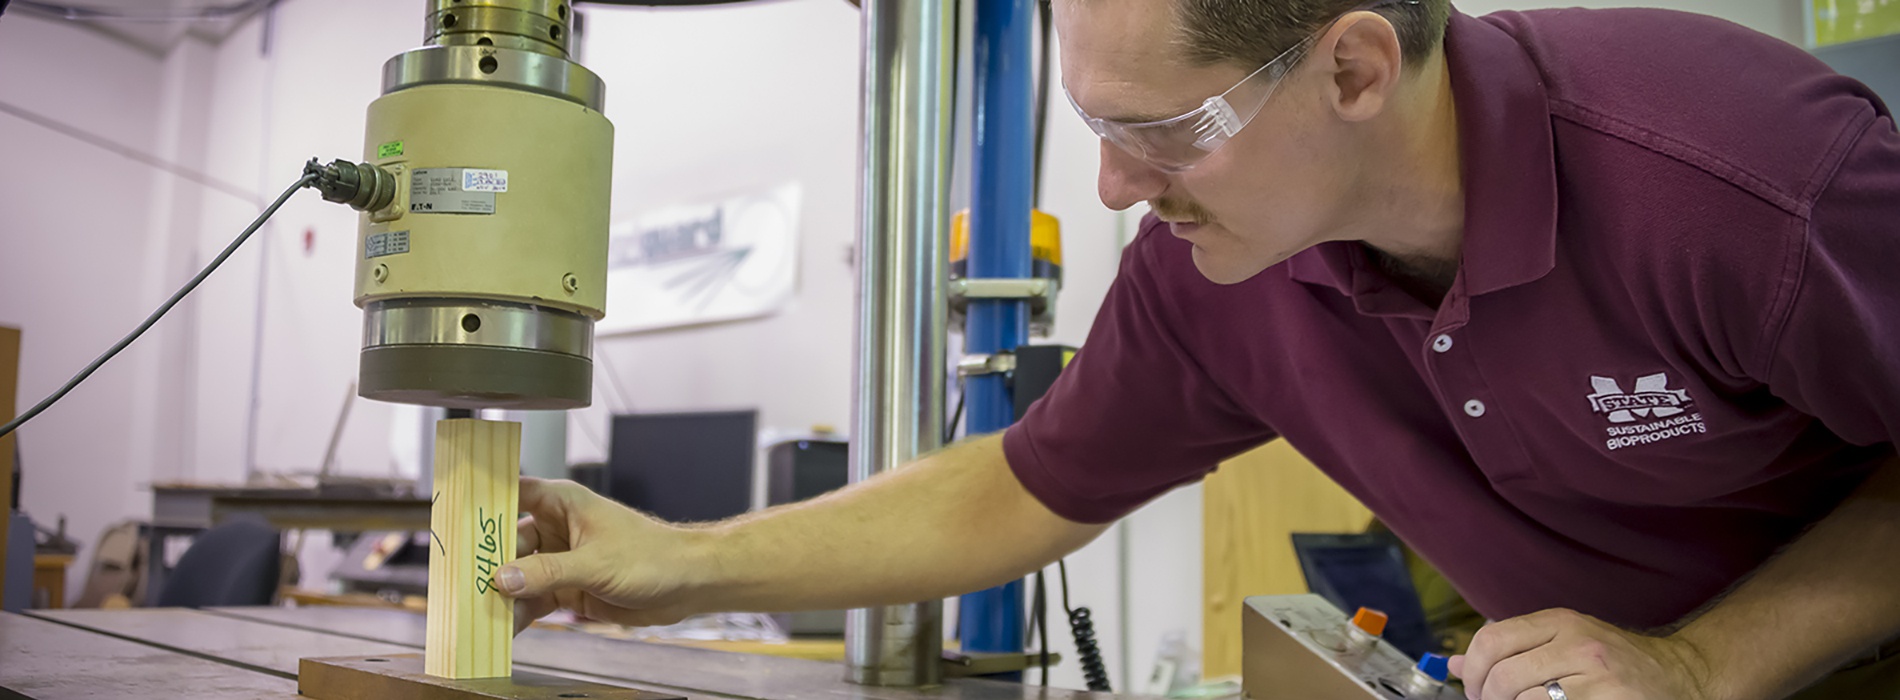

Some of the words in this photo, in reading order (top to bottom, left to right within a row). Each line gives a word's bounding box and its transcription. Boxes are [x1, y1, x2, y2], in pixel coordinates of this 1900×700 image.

[1602, 395, 1671, 410] STATE
[1606, 412, 1702, 437] SUSTAINABLE
[1606, 421, 1707, 450] BIOPRODUCTS
[475, 507, 499, 595] 8465
